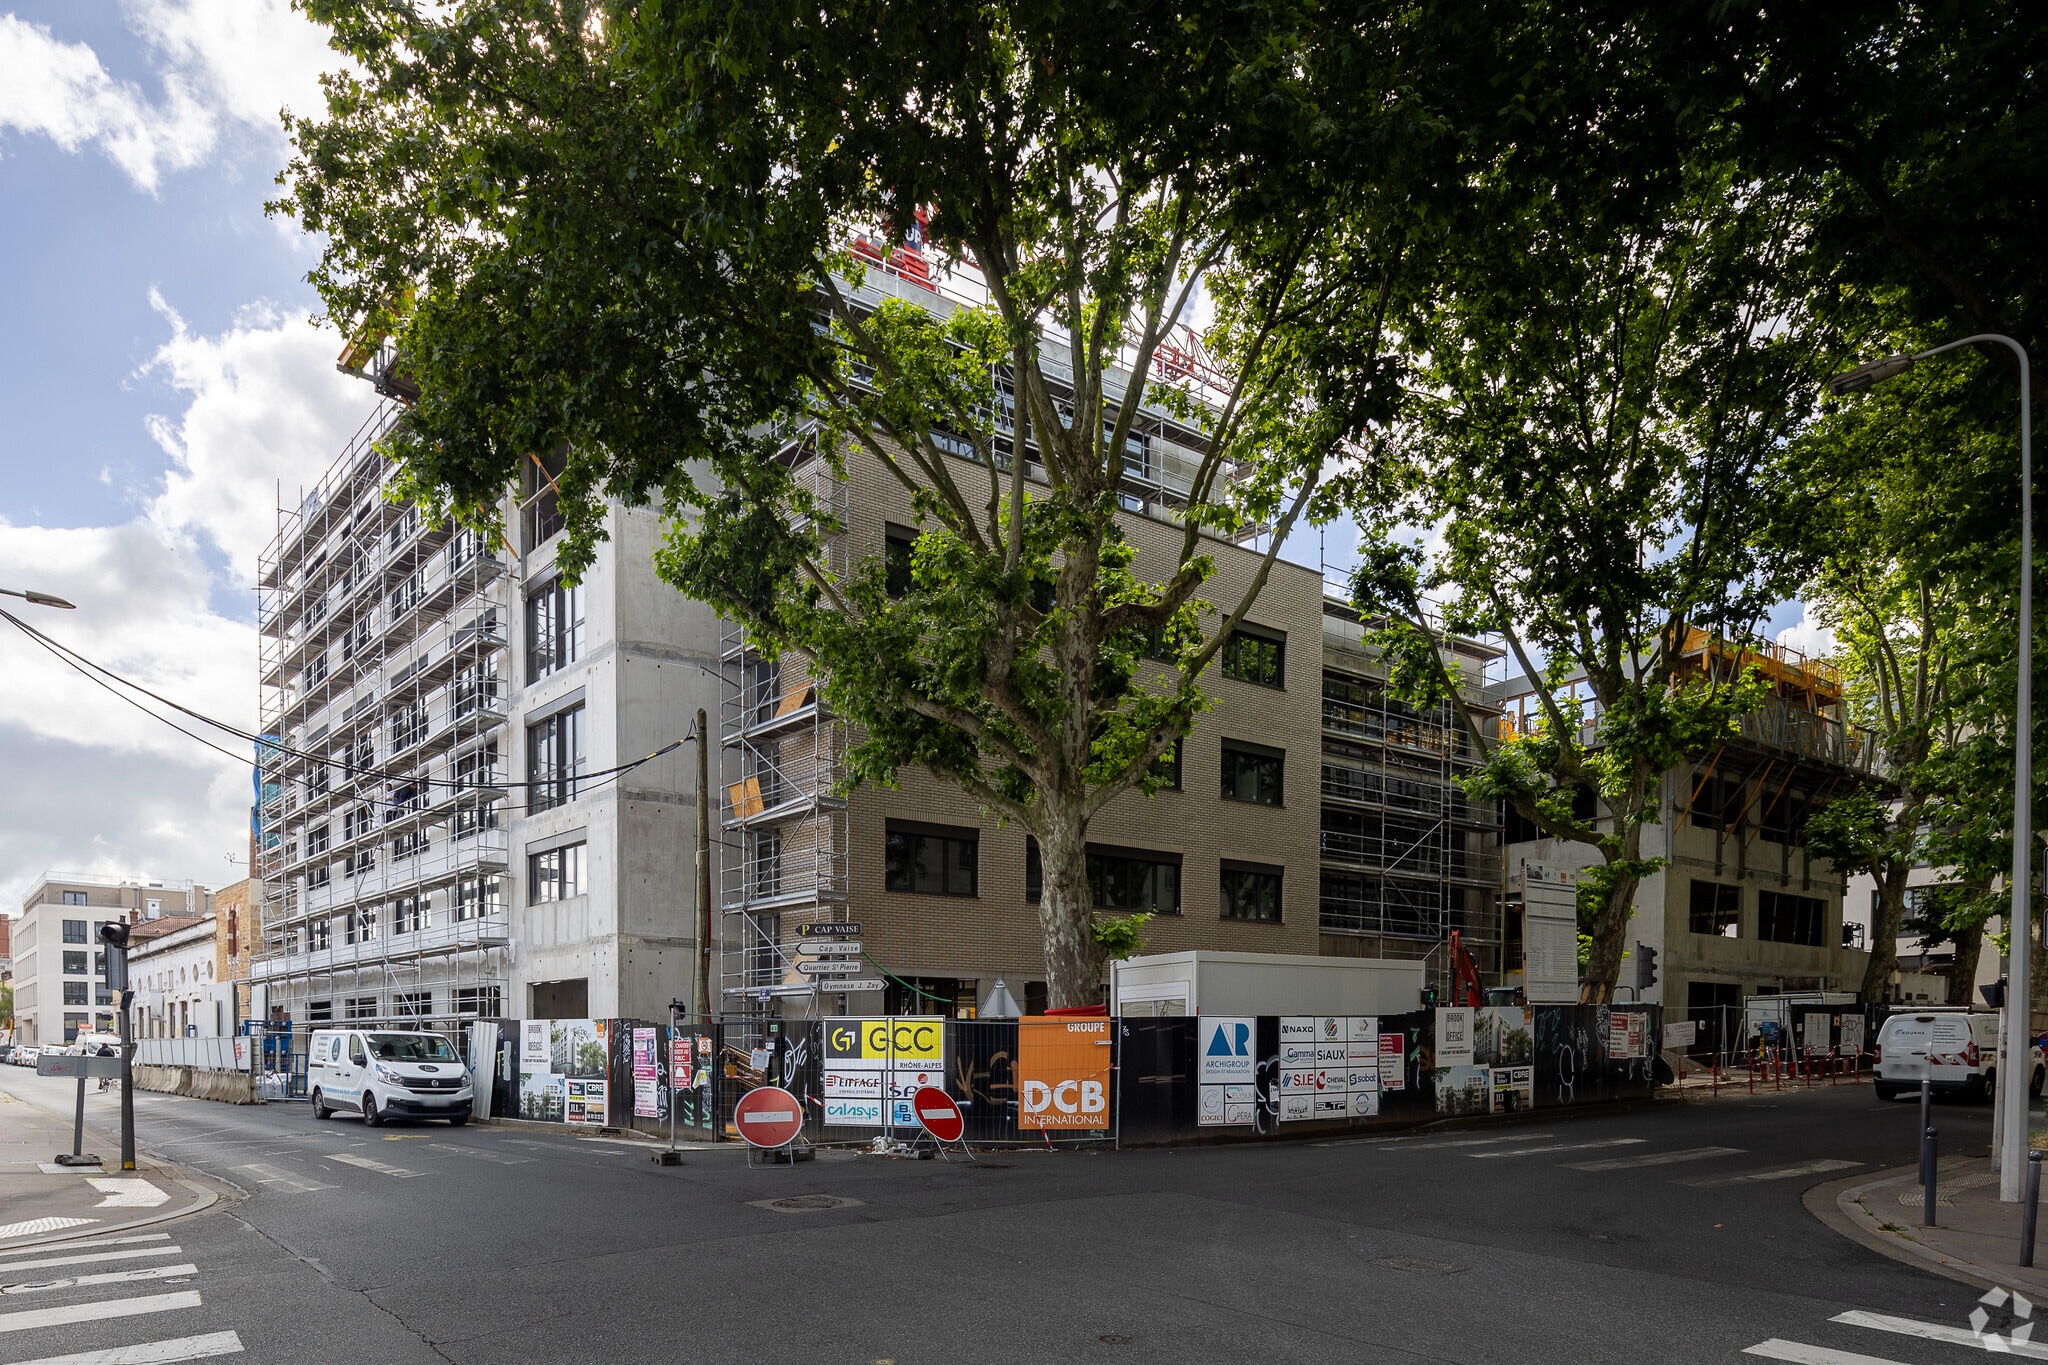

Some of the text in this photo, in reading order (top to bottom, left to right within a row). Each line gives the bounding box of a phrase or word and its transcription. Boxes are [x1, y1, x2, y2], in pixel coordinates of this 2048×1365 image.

[801, 924, 810, 935] P
[1067, 1023, 1104, 1032] GROUPE
[869, 1027, 934, 1052] GCC
[1288, 1048, 1314, 1057] Gamma
[1317, 1050, 1345, 1060] SiAUX
[1358, 1072, 1376, 1083] sobat
[839, 1078, 879, 1088] EIFFAGE
[1023, 1080, 1105, 1113] DCB
[570, 1104, 580, 1112] JLL
[1024, 1115, 1104, 1125] INTERNATIONAL
